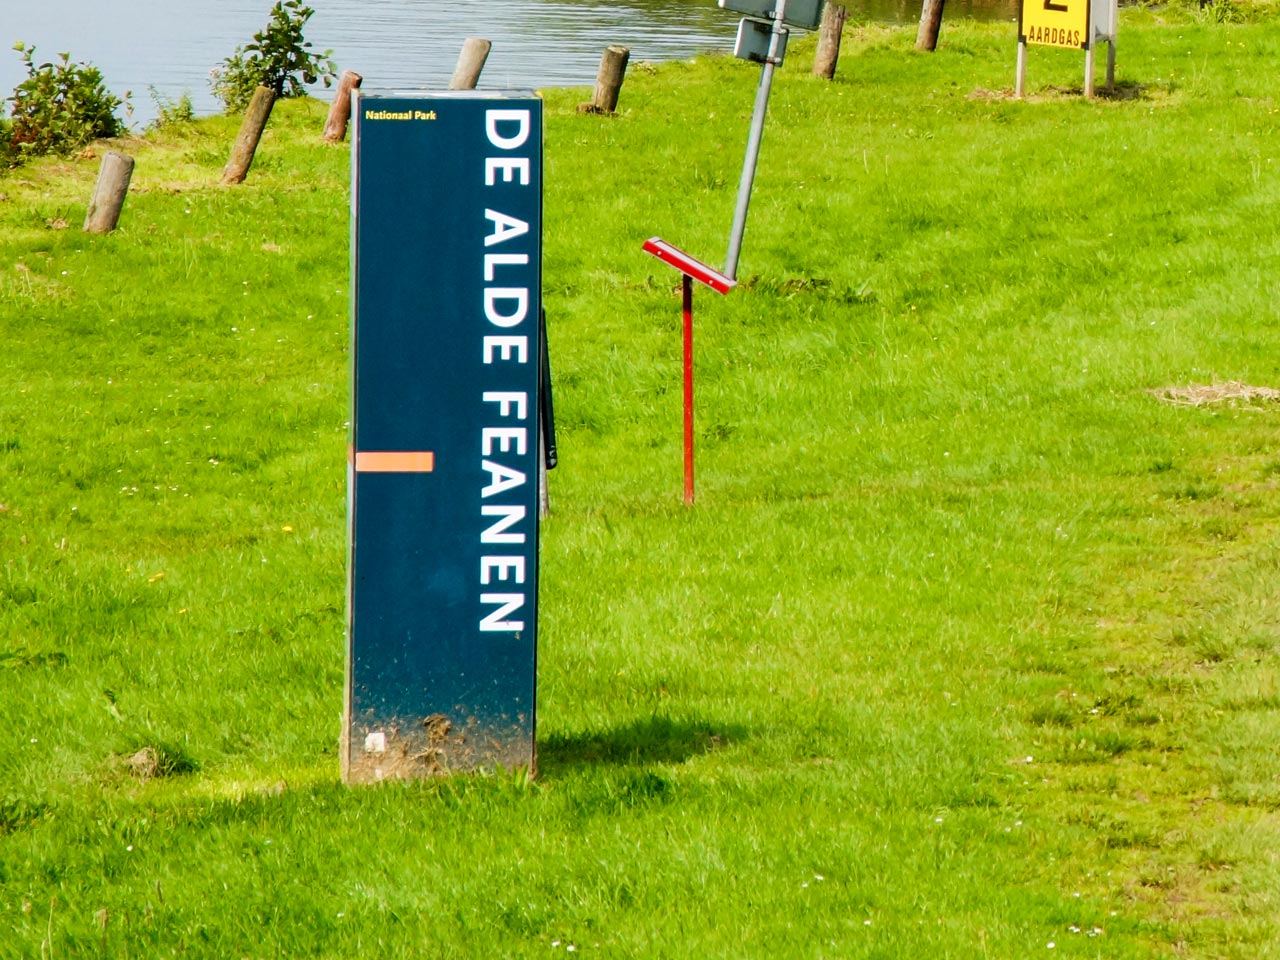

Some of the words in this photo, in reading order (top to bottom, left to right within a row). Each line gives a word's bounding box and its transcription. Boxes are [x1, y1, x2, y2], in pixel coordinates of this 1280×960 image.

[1028, 25, 1080, 47] AARDGAS
[365, 109, 412, 120] Nationaal
[414, 109, 437, 120] Park
[484, 108, 531, 186] DE
[483, 208, 530, 365] ALDE
[479, 391, 528, 632] FEANEN
